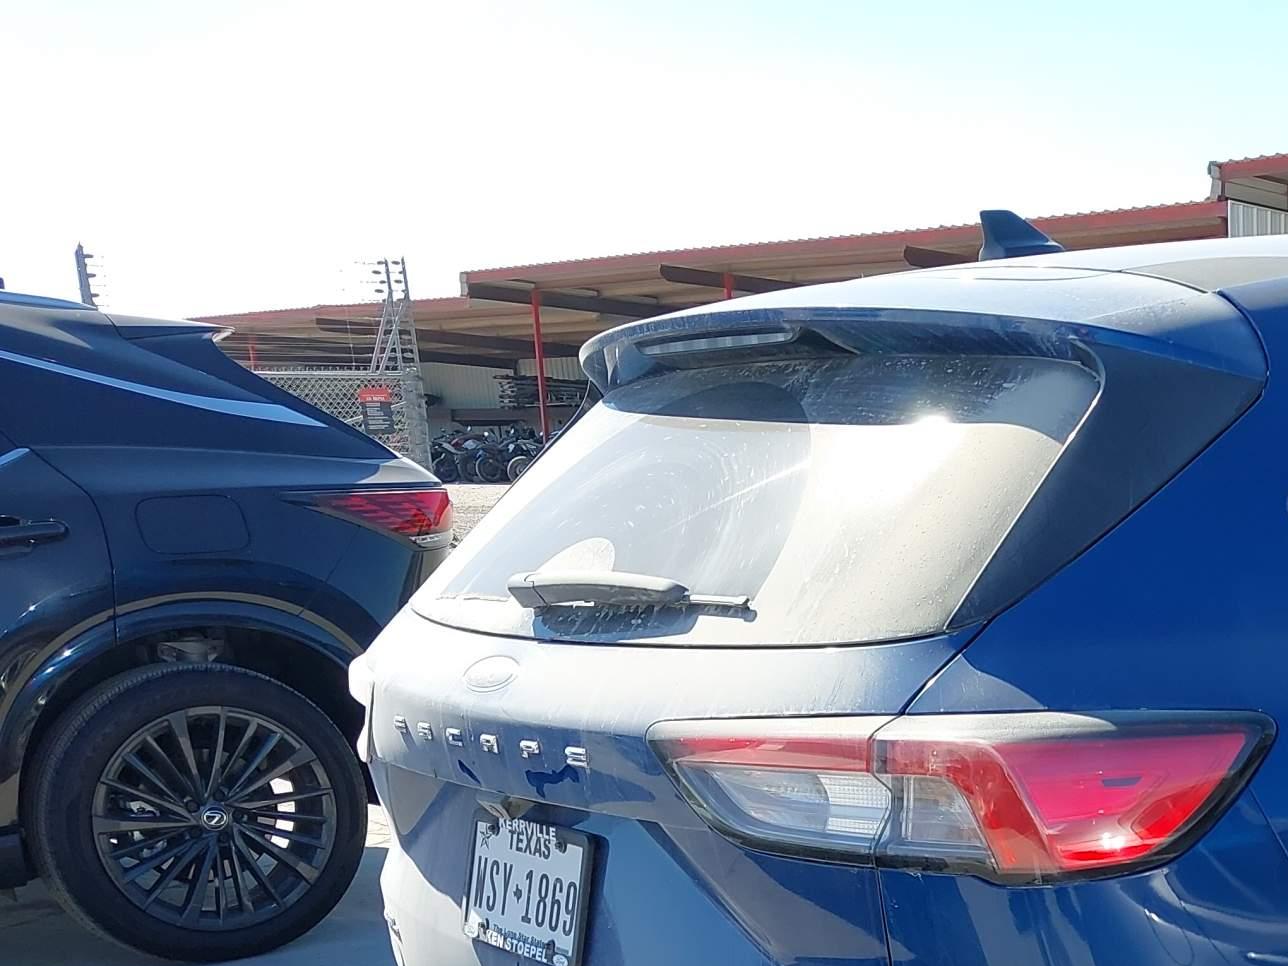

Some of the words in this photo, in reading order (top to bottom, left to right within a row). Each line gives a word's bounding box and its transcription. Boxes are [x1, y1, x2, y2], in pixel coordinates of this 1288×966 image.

[393, 715, 588, 768] ESCAPE
[499, 818, 556, 842] KERRVILLE
[508, 829, 551, 860] TEXAS
[486, 930, 503, 948] KEN
[504, 938, 548, 963] STOEPEL
